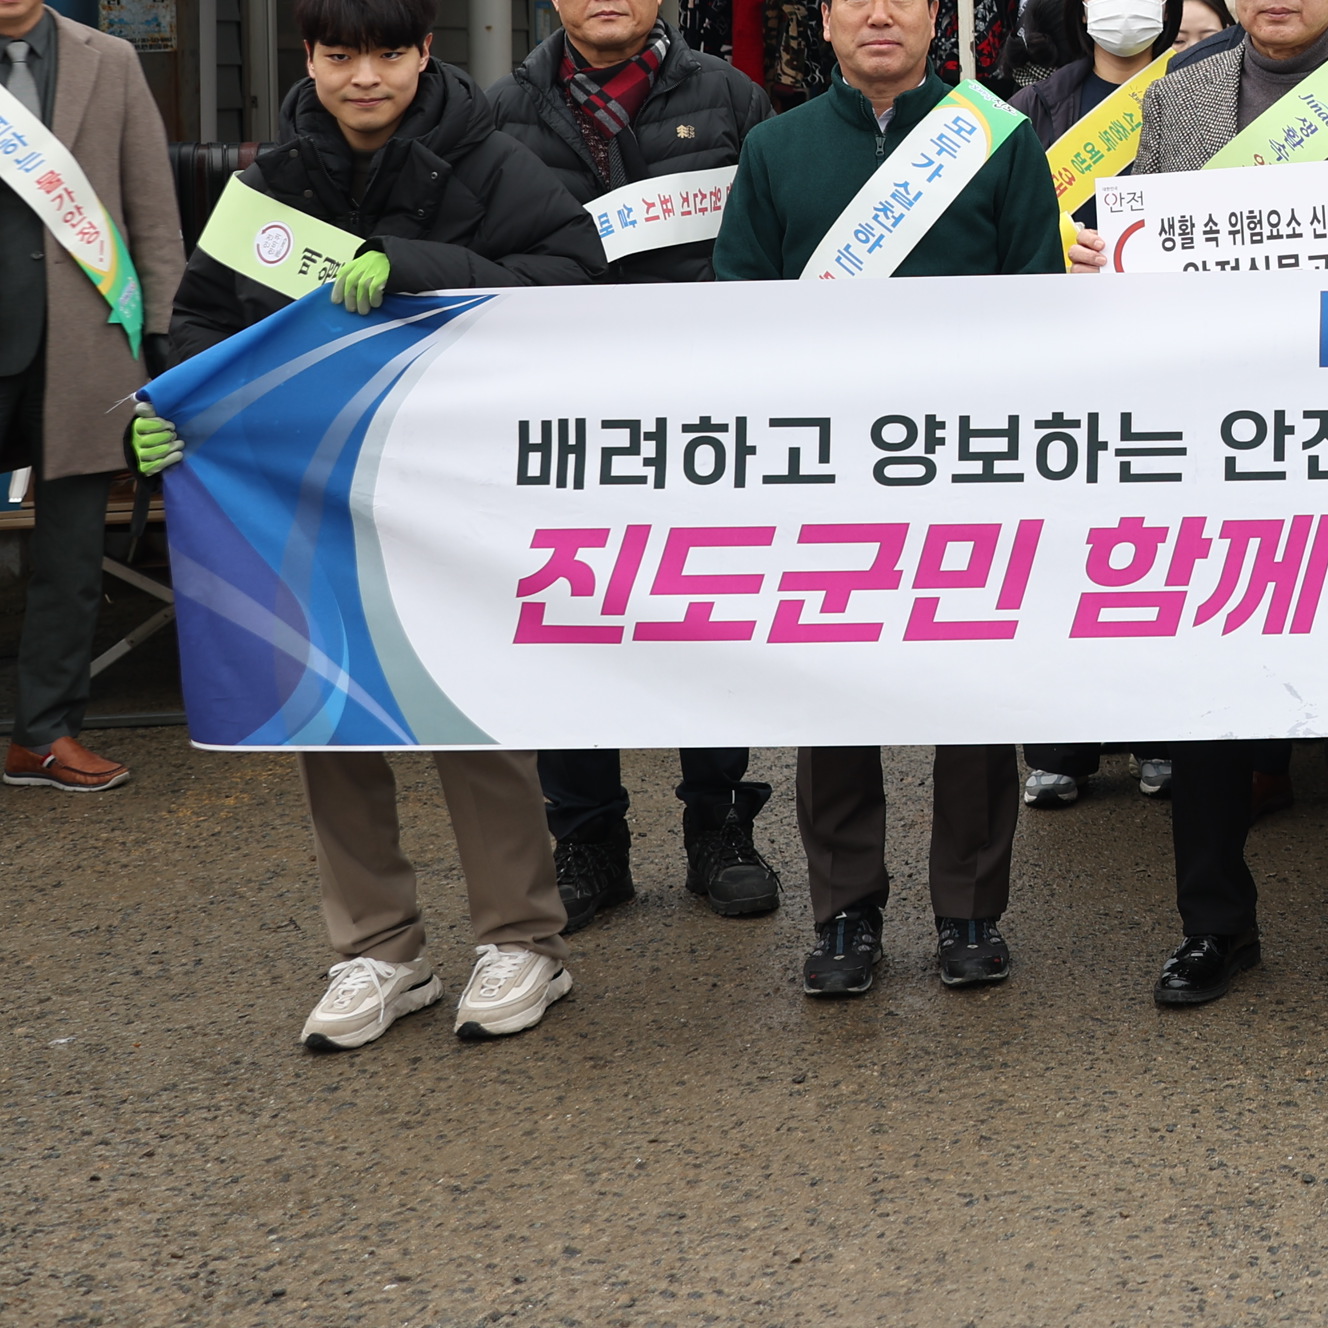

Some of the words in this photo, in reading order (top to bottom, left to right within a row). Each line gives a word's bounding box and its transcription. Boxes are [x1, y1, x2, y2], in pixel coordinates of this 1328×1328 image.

[1104, 190, 1145, 213] 안전
[1158, 214, 1195, 252] 생활
[1202, 218, 1221, 248] 속
[1228, 207, 1304, 246] 위험요소
[516, 415, 836, 490] 배려하고
[870, 411, 1187, 487] 양보하는
[513, 519, 1045, 645] 진도군민
